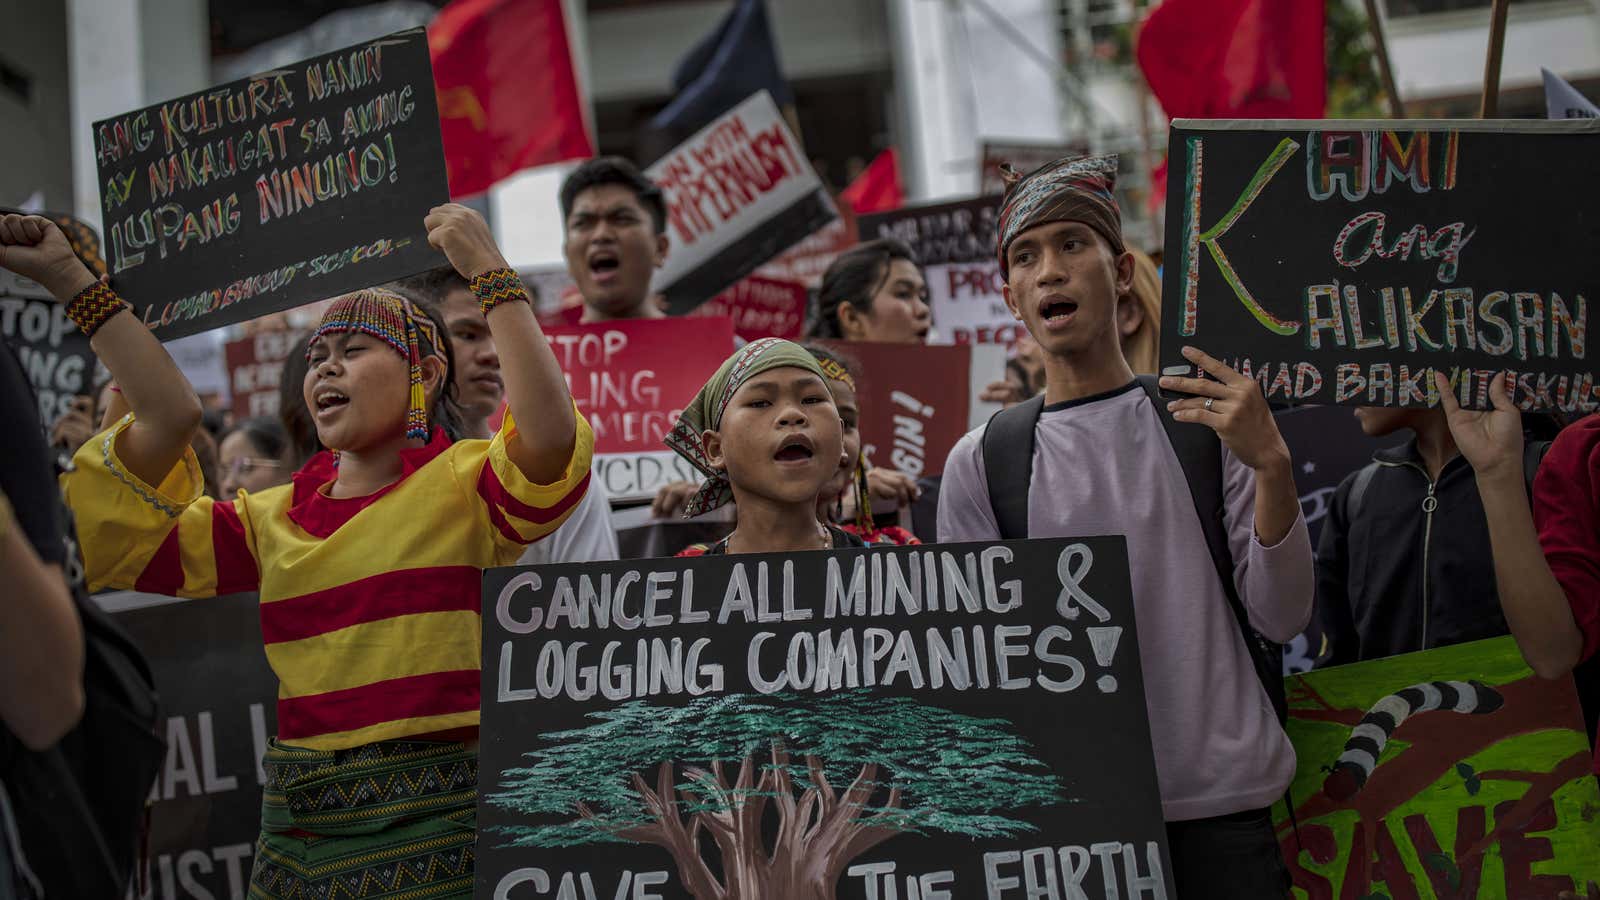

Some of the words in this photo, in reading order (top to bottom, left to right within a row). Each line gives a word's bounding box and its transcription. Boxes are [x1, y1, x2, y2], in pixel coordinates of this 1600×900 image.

[98, 116, 154, 167] ANG
[161, 76, 294, 154] KULTURA
[306, 45, 383, 103] NAMIN
[105, 168, 136, 212] AY
[149, 118, 295, 203] NAKAUGAT
[300, 119, 332, 154] SA
[342, 85, 415, 144] AMING
[112, 192, 240, 274] LUPANG
[256, 132, 398, 225] NINUNO!
[1333, 211, 1476, 284] ang
[547, 329, 629, 369] TOP
[496, 568, 710, 634] CANCEL
[717, 560, 812, 624] ALL
[824, 546, 1022, 618] MINING
[1056, 543, 1111, 622] &
[497, 637, 724, 702] LOGGING
[748, 624, 1122, 694] COMPANIES!
[149, 711, 238, 801] AL
[493, 867, 669, 900] SAVE
[848, 861, 954, 900] THE
[984, 841, 1167, 900] EARTH
[1281, 798, 1576, 900] SAVE
